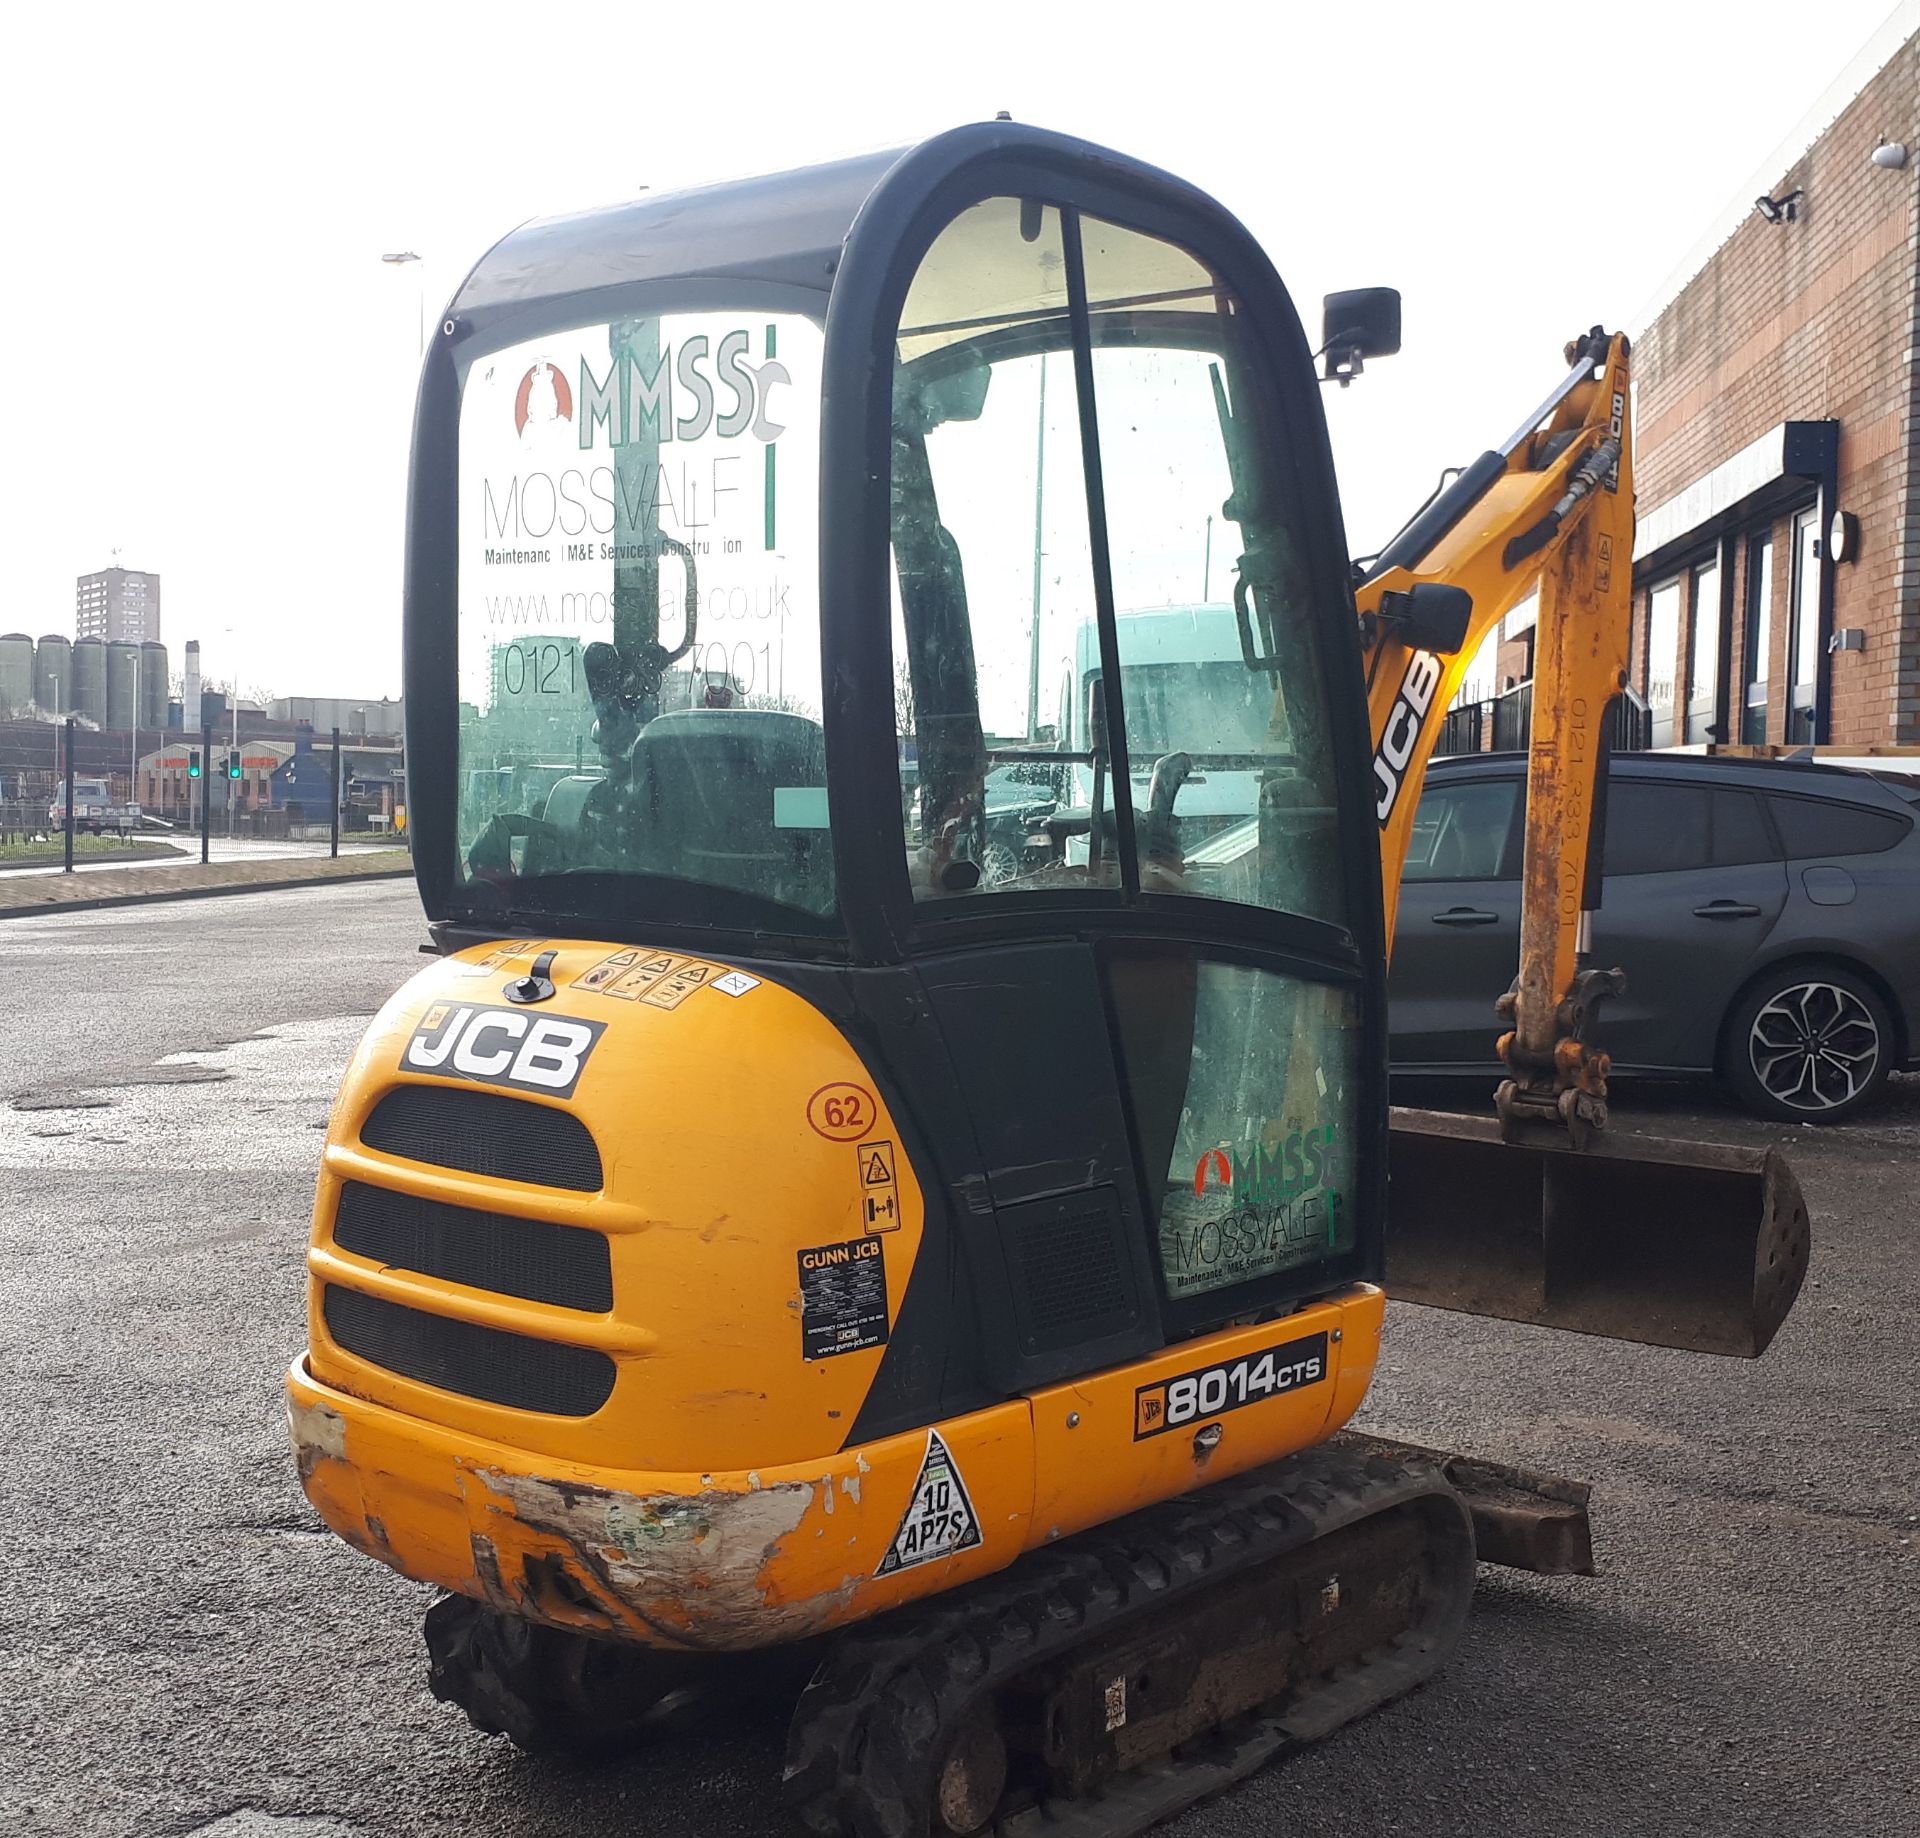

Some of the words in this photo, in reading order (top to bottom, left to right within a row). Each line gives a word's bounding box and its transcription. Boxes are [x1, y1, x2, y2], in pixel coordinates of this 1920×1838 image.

[579, 330, 755, 450] MMSS
[568, 544, 594, 562] M&E
[600, 542, 650, 560] Services
[505, 644, 574, 695] 0121
[685, 641, 770, 695] 7001
[1374, 650, 1441, 820] JCB
[1570, 698, 1587, 765] 0121
[1561, 857, 1580, 928] 7001
[408, 1007, 592, 1088] JCB
[824, 1095, 864, 1128] 62
[1231, 1127, 1321, 1208] MMSS
[802, 1247, 850, 1269] GUNN
[853, 1241, 880, 1260] JCB
[1176, 1197, 1321, 1271] MOSSVALE
[1177, 1265, 1223, 1288] Maintenance
[1228, 1261, 1244, 1275] M&E
[1245, 1254, 1274, 1271] Services
[1145, 1400, 1162, 1419] JCB
